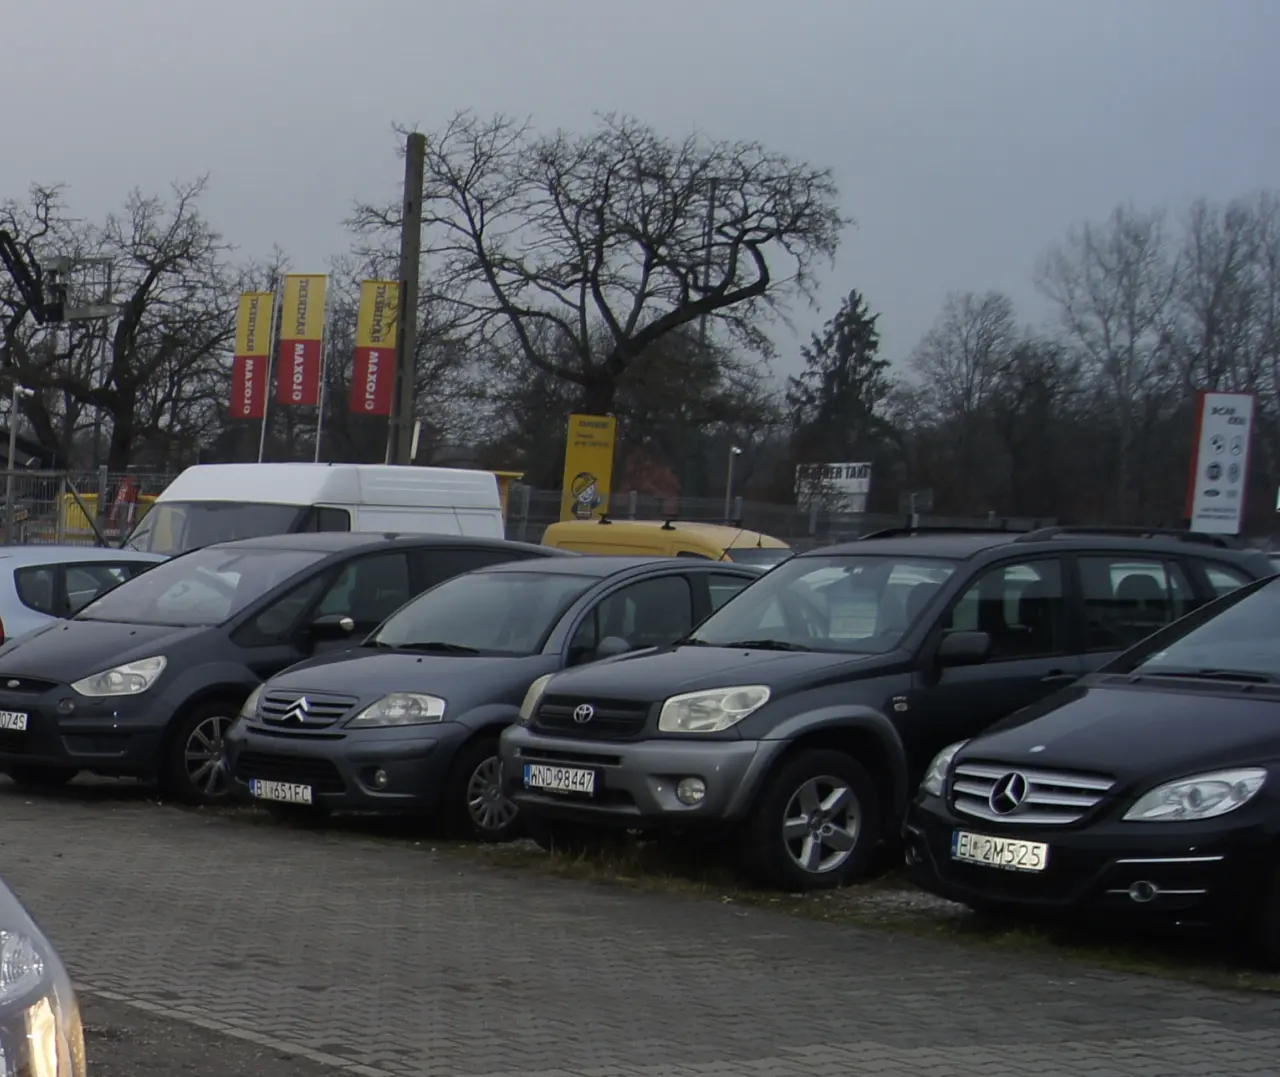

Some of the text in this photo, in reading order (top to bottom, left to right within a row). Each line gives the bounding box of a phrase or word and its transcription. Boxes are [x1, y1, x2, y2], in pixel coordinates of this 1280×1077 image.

[531, 765, 593, 791] WND 98447
[959, 835, 976, 858] EL
[983, 839, 1041, 867] 2M525
